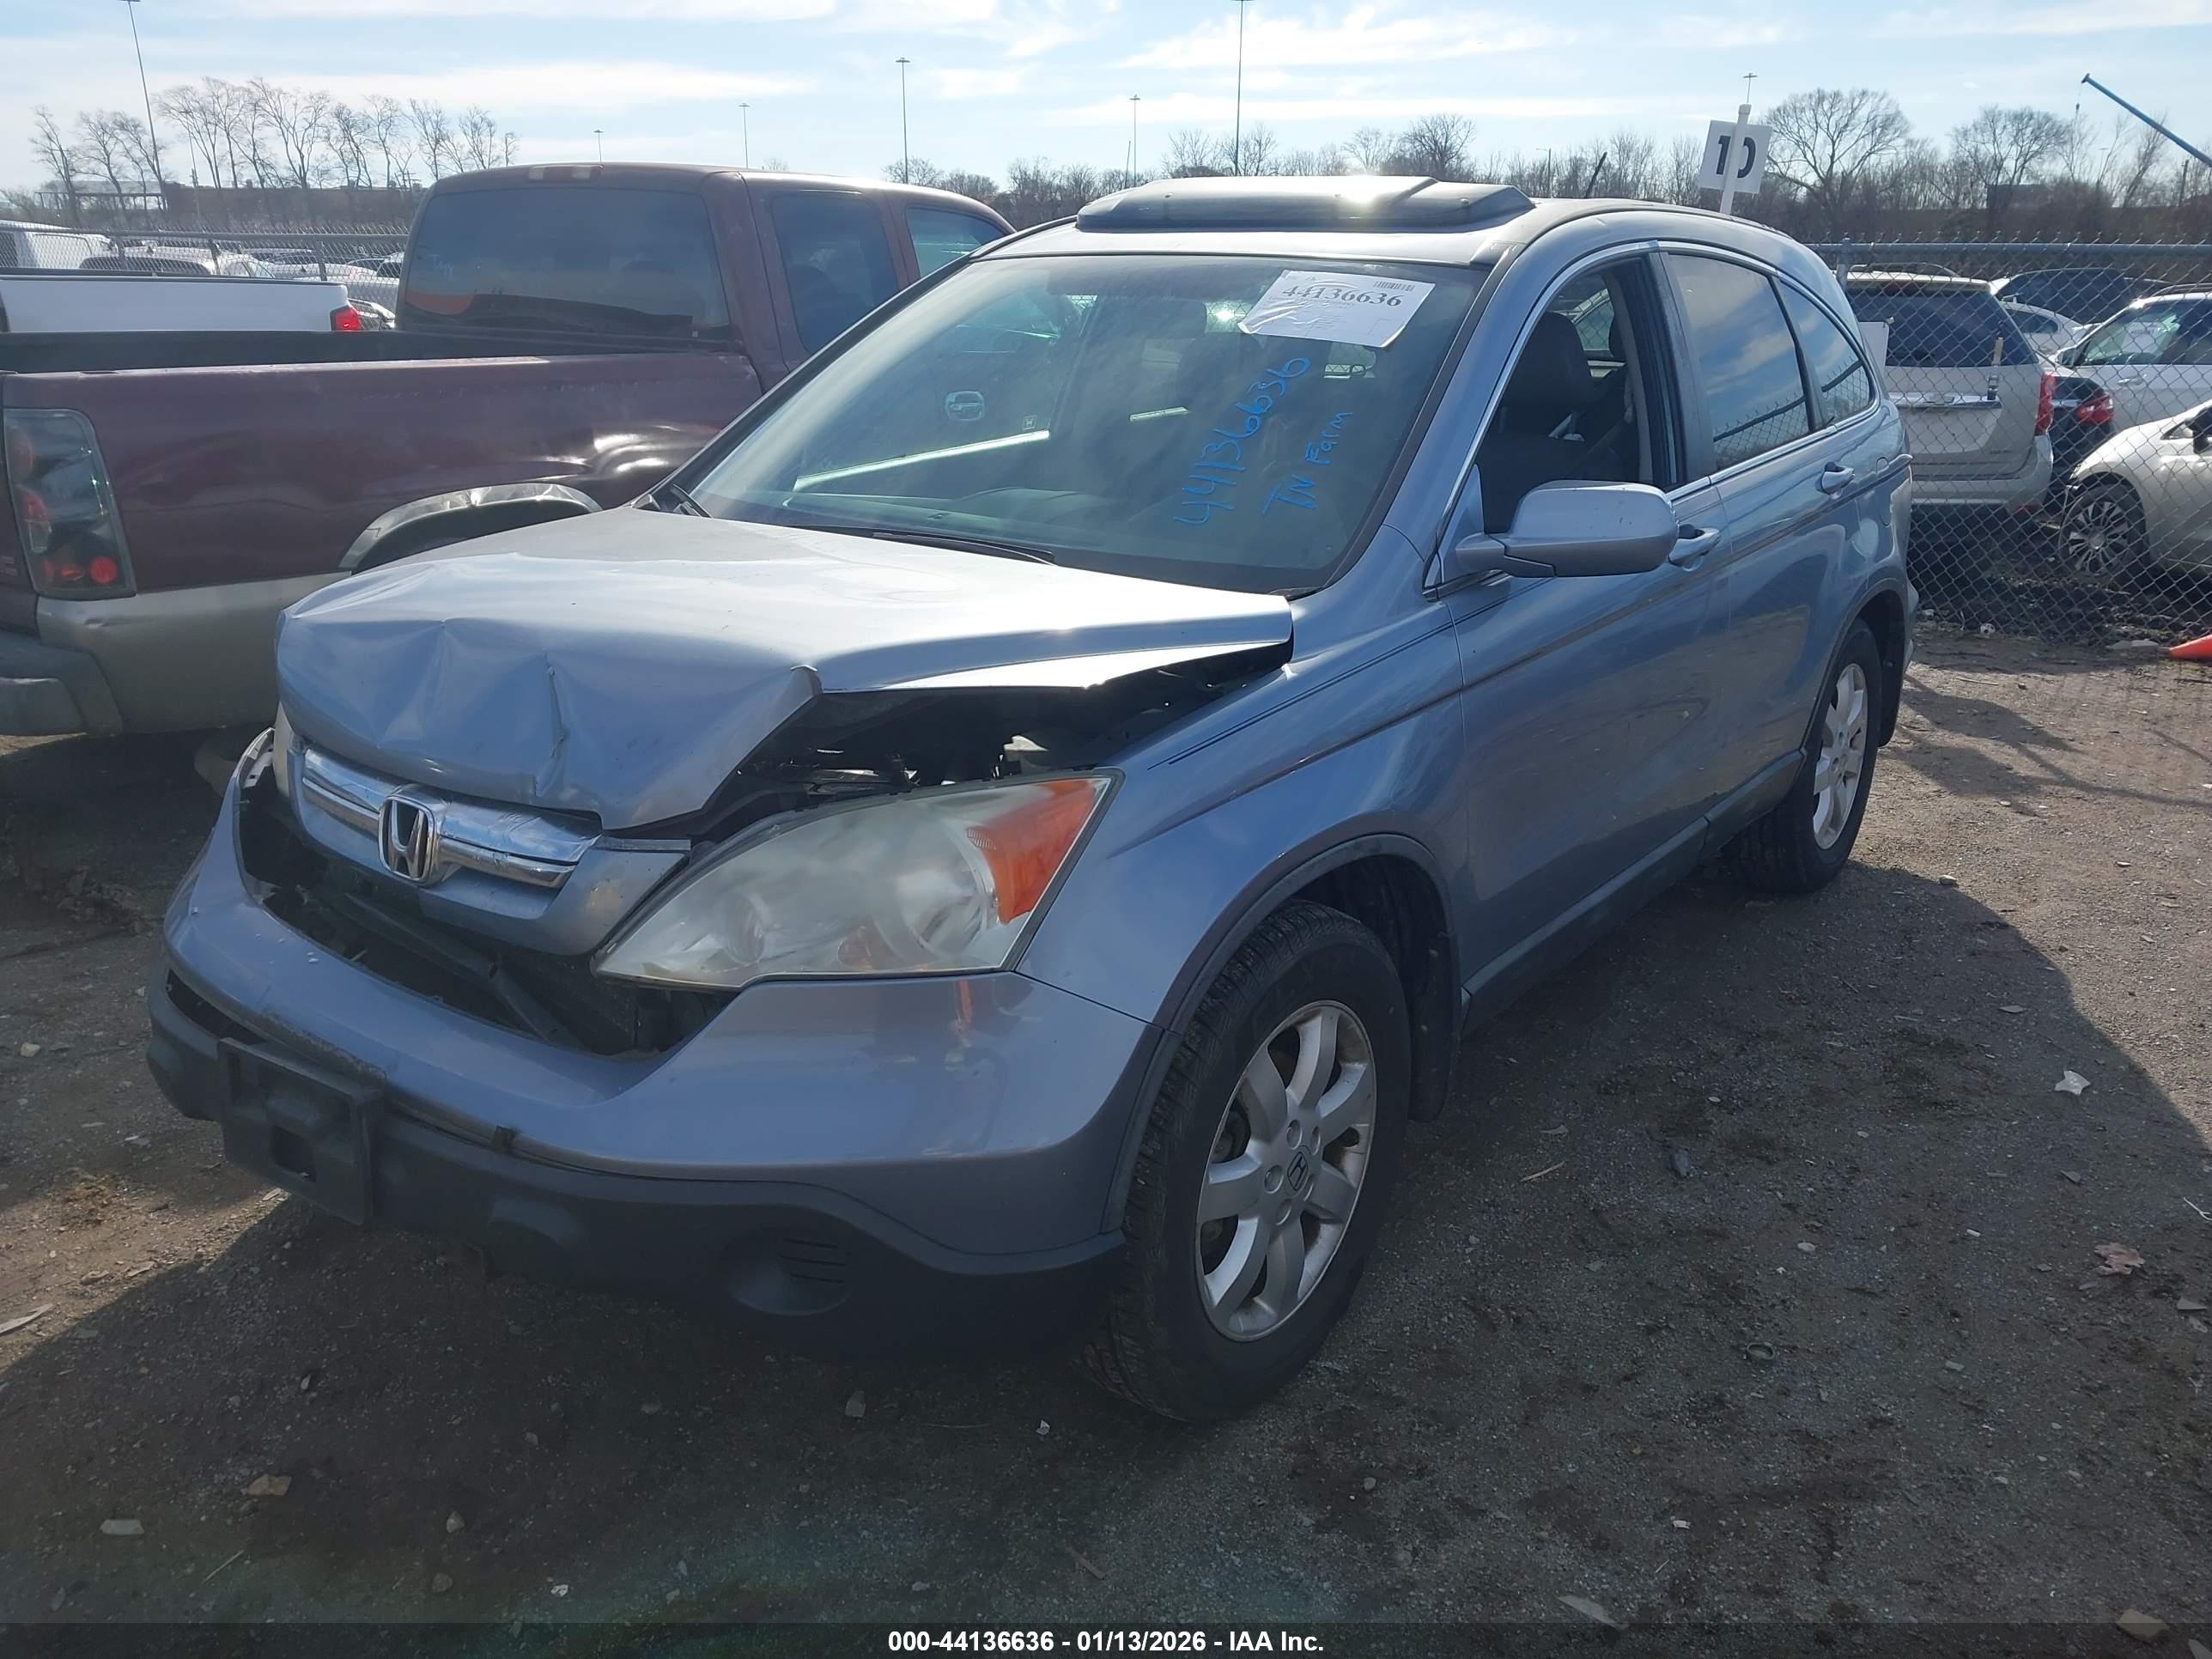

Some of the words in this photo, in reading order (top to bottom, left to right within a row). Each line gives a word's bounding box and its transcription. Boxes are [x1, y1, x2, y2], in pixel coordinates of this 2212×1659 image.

[1282, 285, 1404, 307] 44136636
[1173, 357, 1311, 524] 44136636
[1304, 411, 1354, 465] Farm
